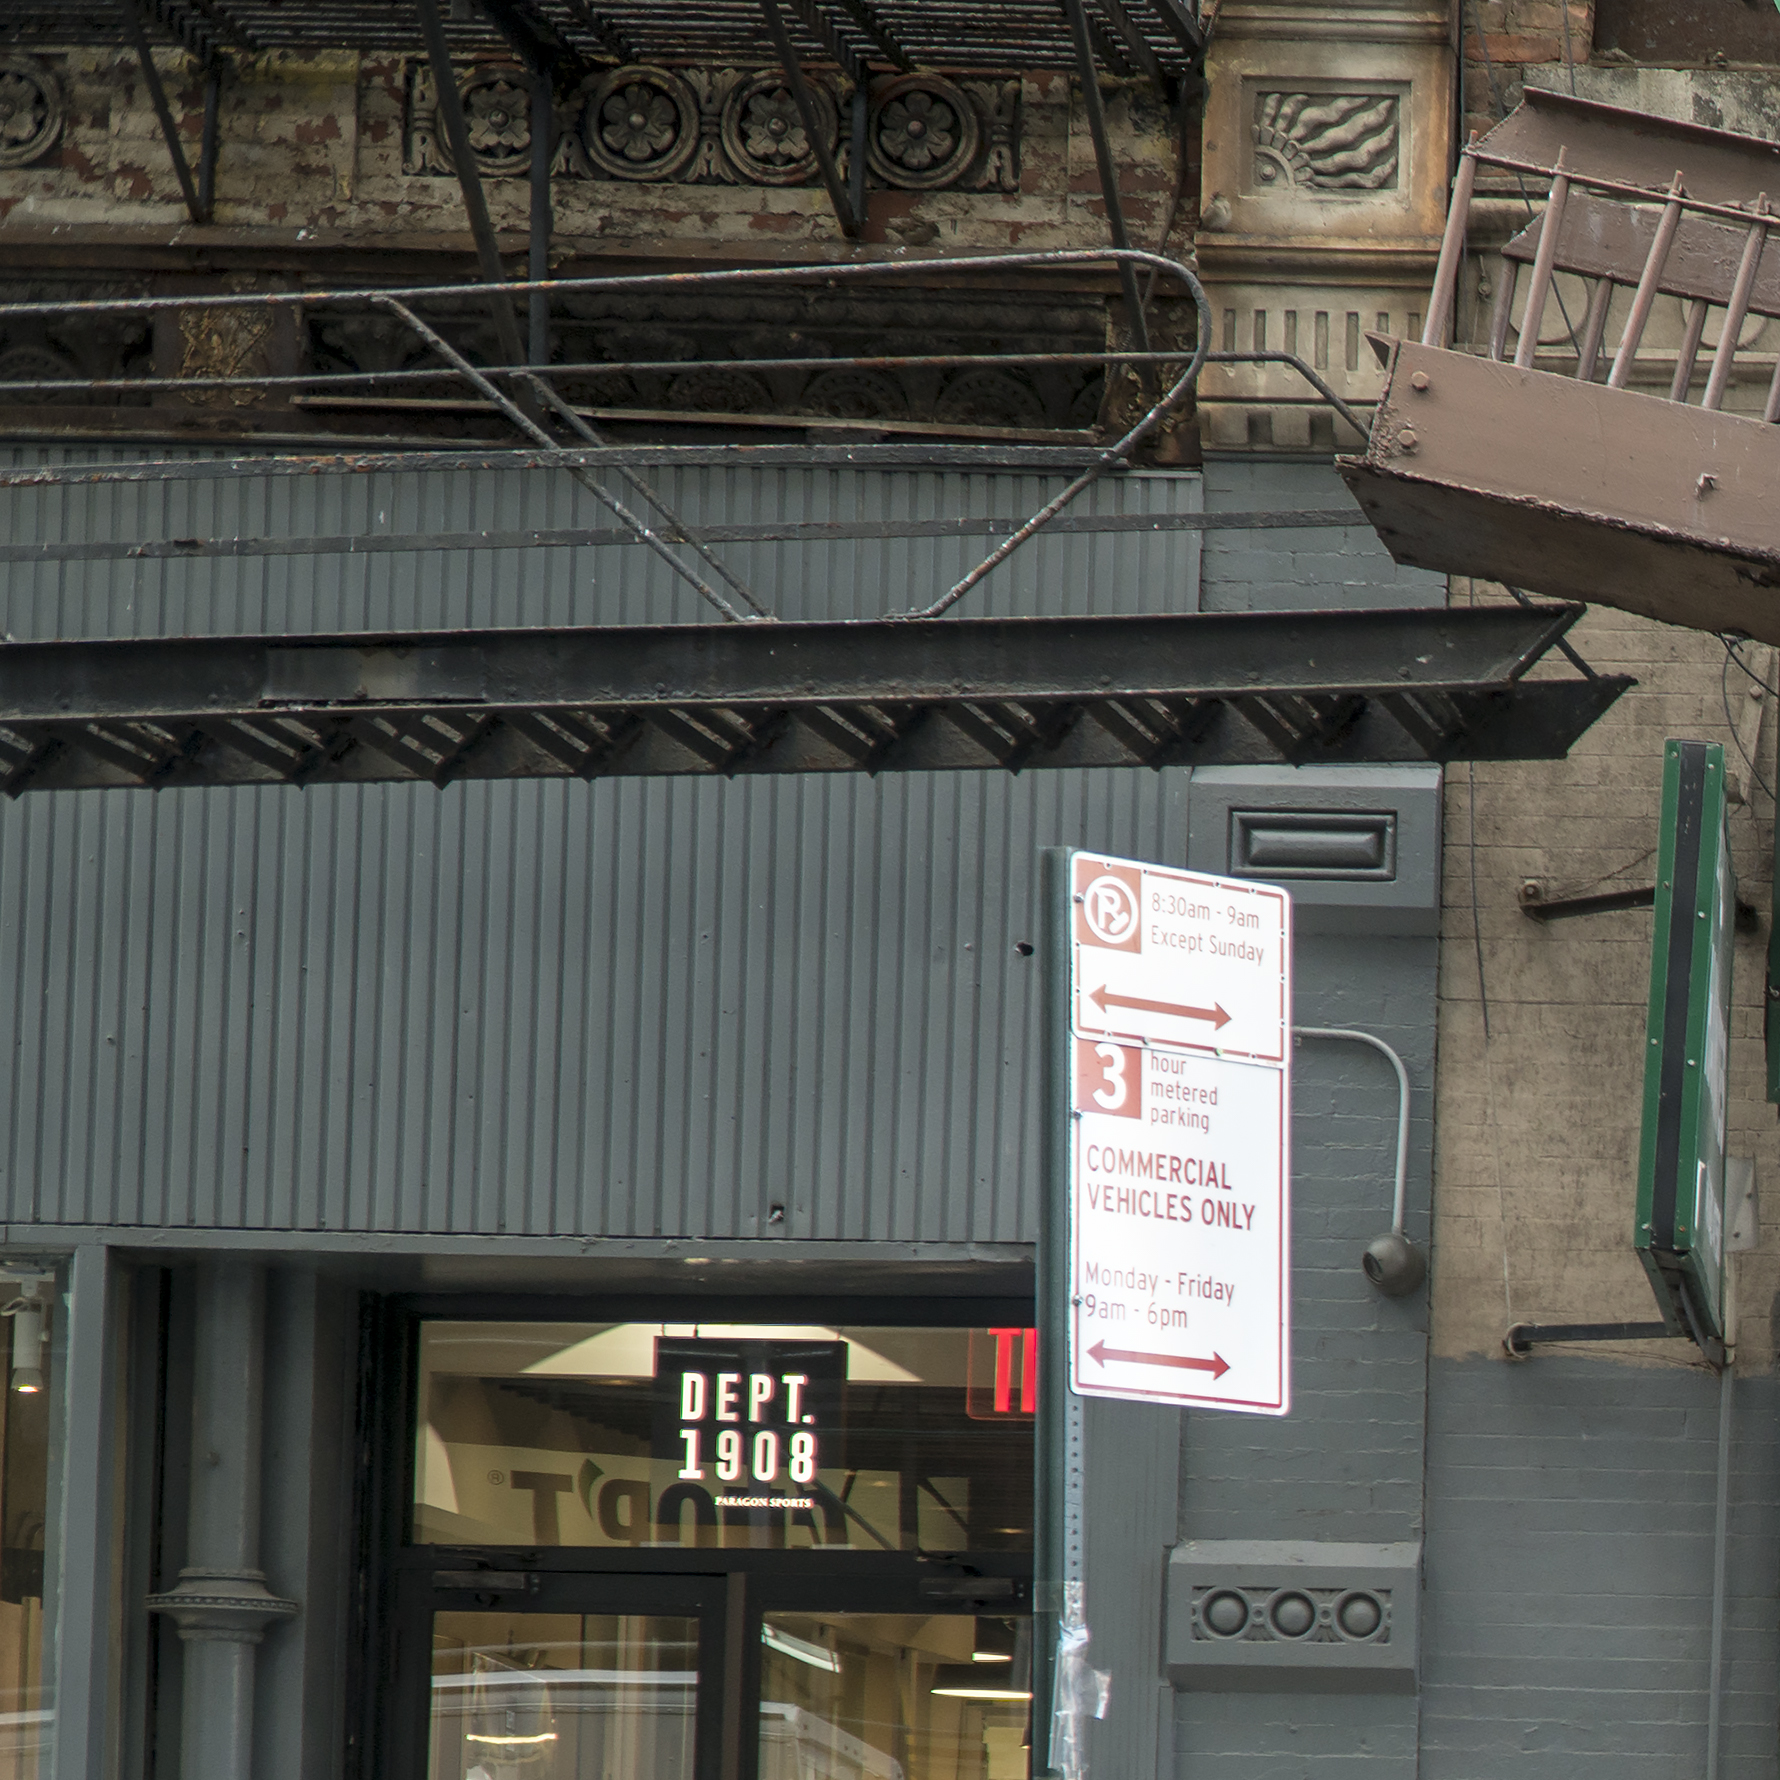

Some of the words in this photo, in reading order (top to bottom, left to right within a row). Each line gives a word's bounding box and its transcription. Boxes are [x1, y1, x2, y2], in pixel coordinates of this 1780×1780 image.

[1151, 892, 1210, 921] 8:30am
[1227, 905, 1260, 929] 9am
[1151, 925, 1203, 954] Except
[1209, 935, 1265, 966] Sunday
[1092, 1042, 1127, 1110] 3
[1151, 1051, 1186, 1075] hour
[1151, 1081, 1218, 1106] metered
[1150, 1107, 1210, 1135] parking
[1087, 1144, 1232, 1190] COMMERCIAL
[1087, 1182, 1192, 1223] VEHICLES
[1201, 1198, 1256, 1231] ONLY
[1086, 1261, 1158, 1297] Monday
[1178, 1272, 1235, 1307] Friday
[1085, 1294, 1126, 1321] 9am
[1147, 1302, 1187, 1330] 6pm
[680, 1371, 815, 1425] DEPT.
[677, 1428, 817, 1483] 1908
[714, 1495, 768, 1507] PARAGON
[769, 1497, 815, 1509] SPORTS
